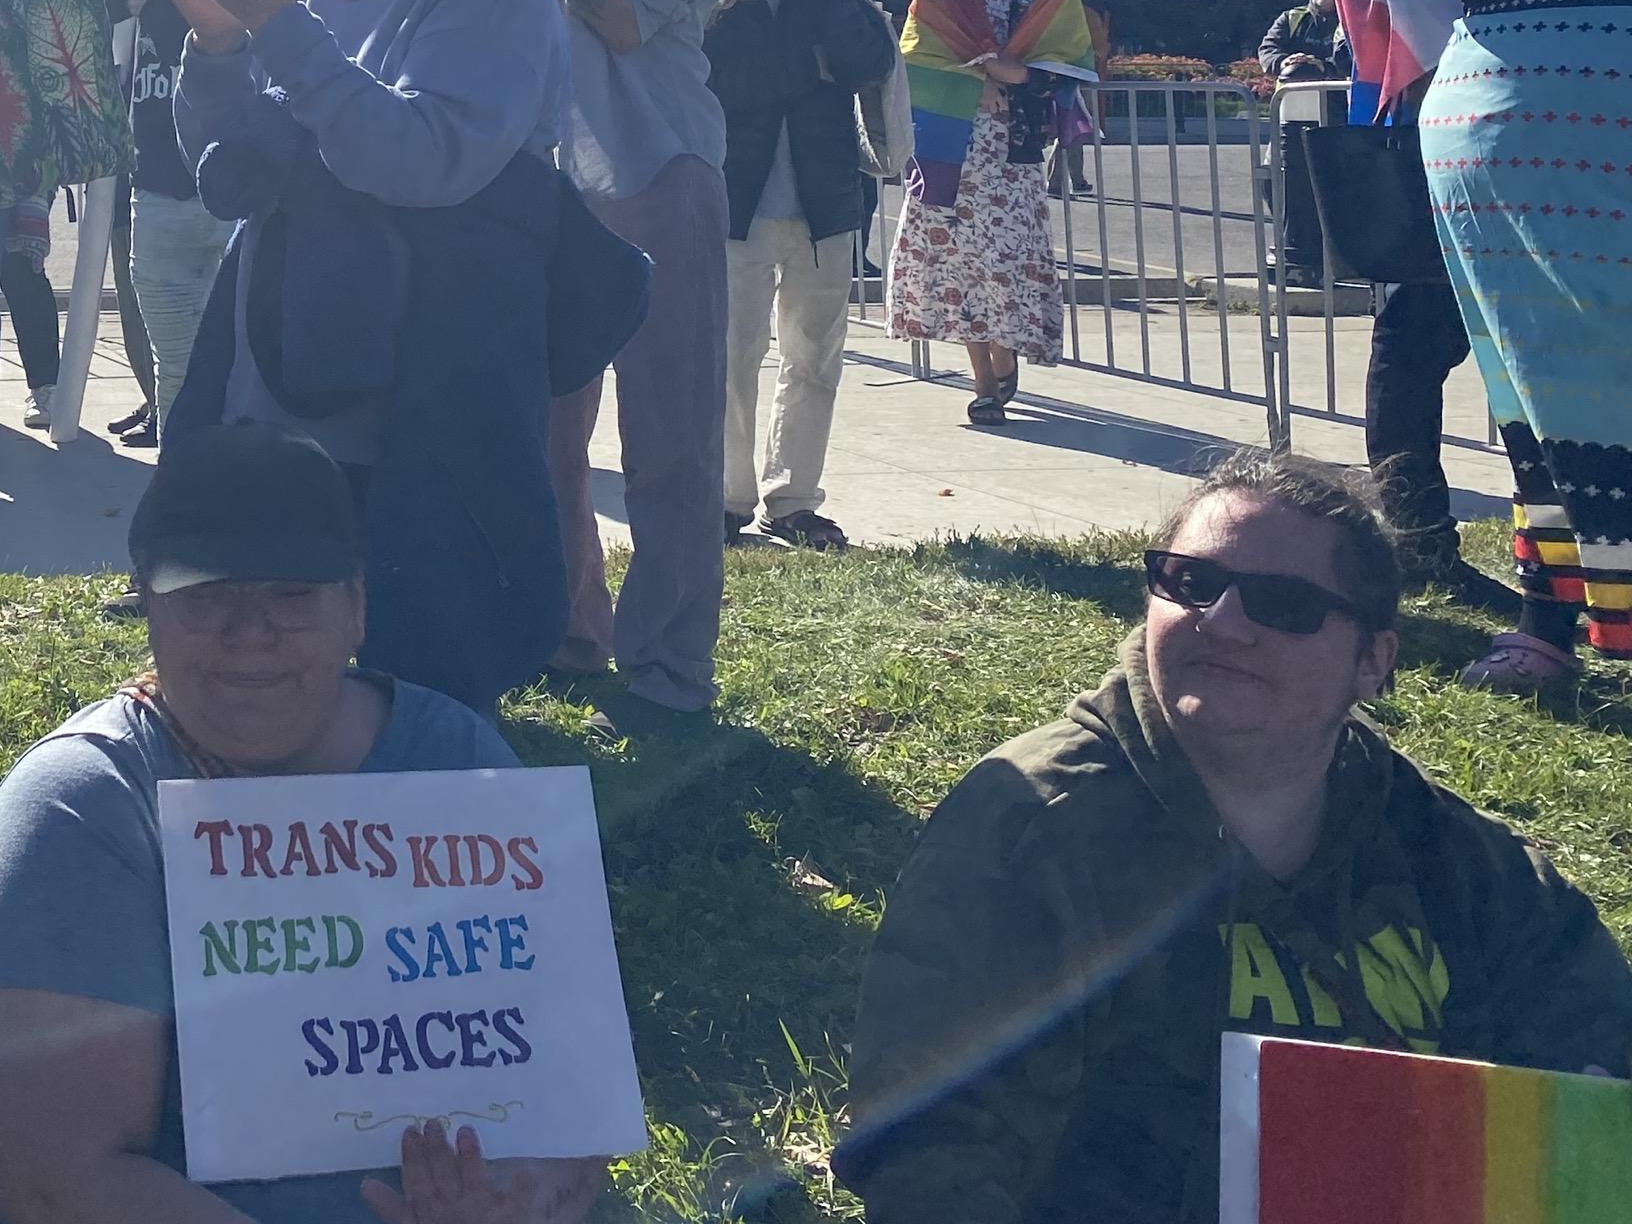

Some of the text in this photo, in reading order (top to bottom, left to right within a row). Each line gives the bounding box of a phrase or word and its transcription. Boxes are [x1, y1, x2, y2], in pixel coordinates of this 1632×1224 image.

[194, 819, 544, 891] TRANS KIDS
[199, 914, 536, 982] NEED SAFE
[301, 1006, 533, 1077] SPACES
